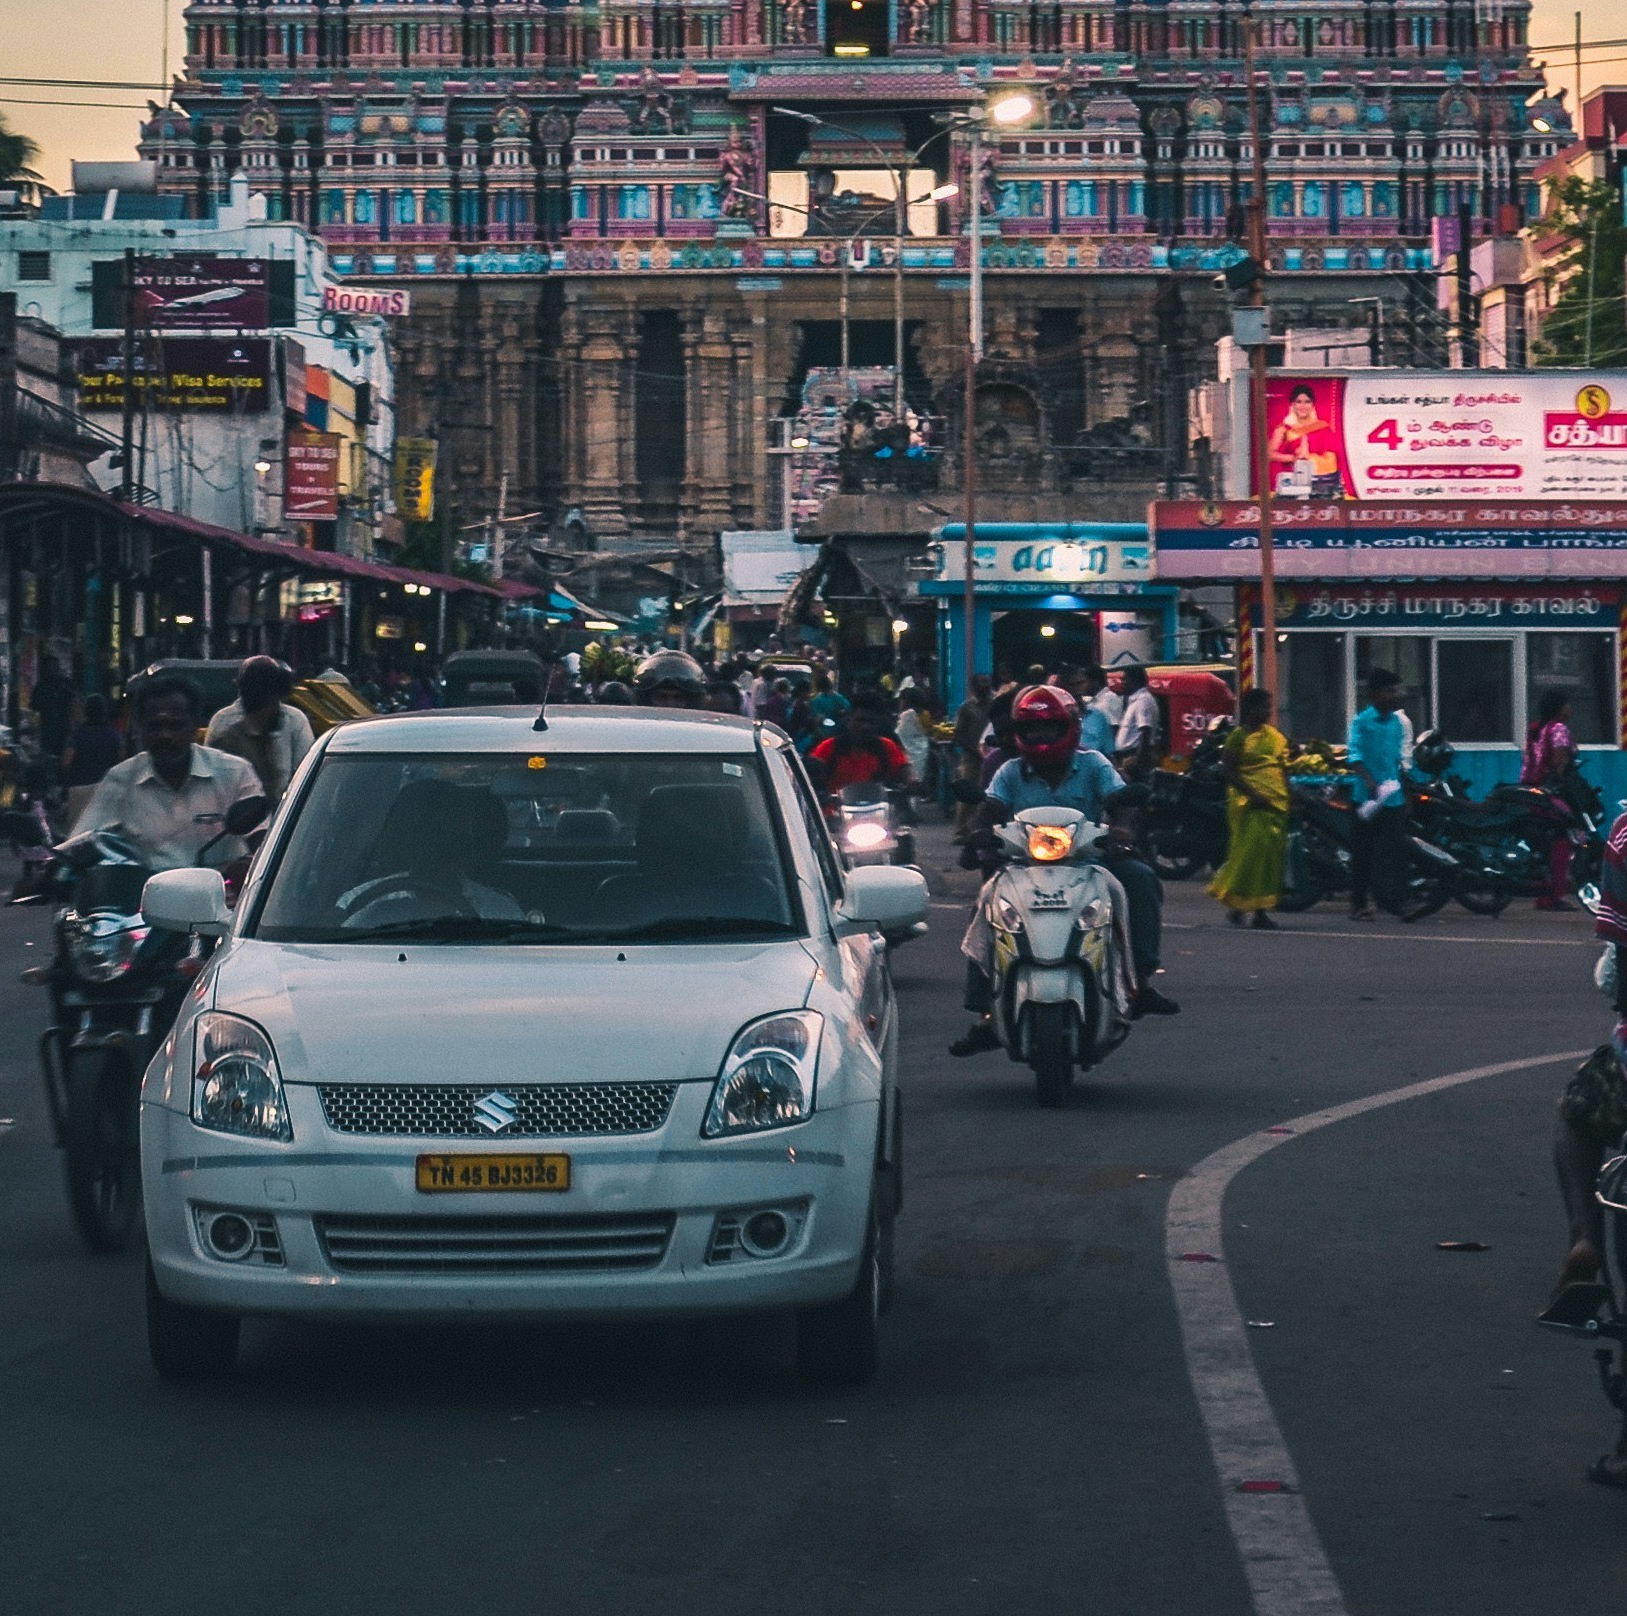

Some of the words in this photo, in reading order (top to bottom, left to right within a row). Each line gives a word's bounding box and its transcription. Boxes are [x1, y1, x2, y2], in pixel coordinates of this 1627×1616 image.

[325, 287, 405, 314] ROOMS
[1367, 418, 1404, 451] 4
[1349, 508, 1467, 524] மாநகர
[1349, 557, 1496, 572] UNION
[1307, 589, 1397, 620] திருச்சி
[1404, 596, 1505, 620] மாநகர
[1510, 589, 1601, 615] காவல்
[429, 1166, 455, 1185] TN
[460, 1166, 483, 1186] 45
